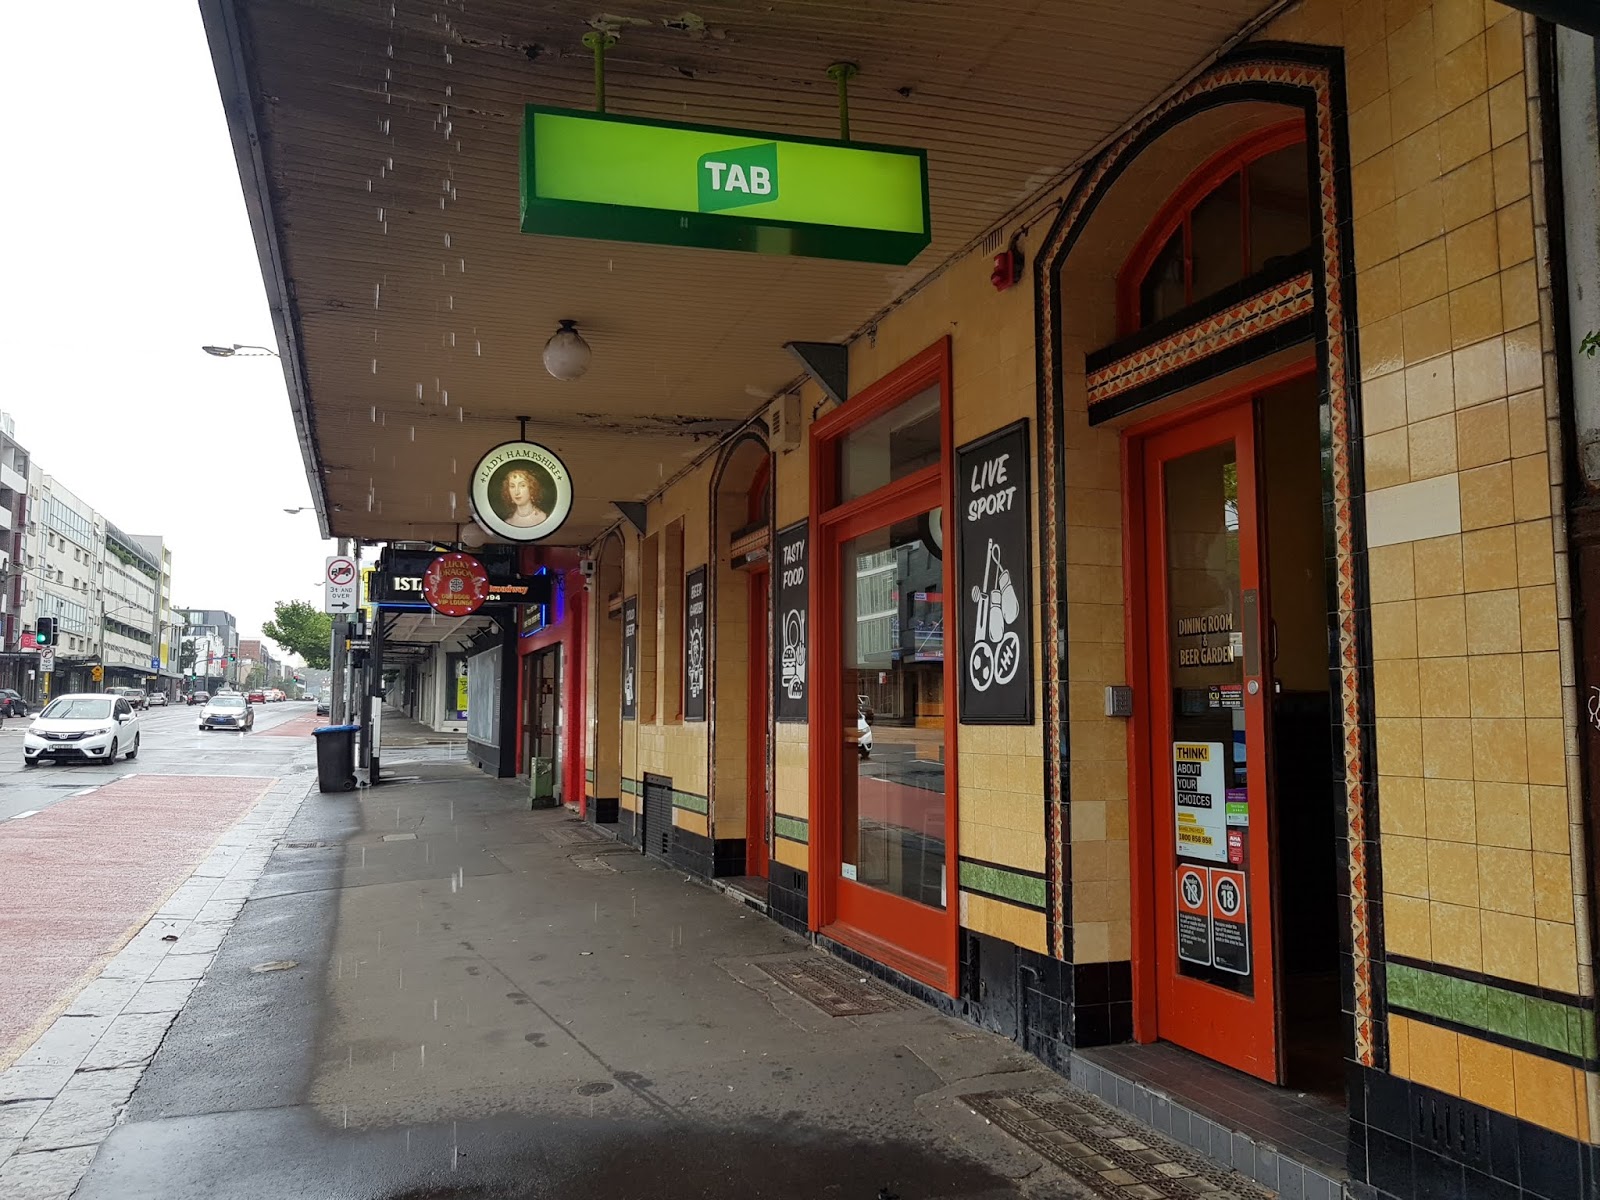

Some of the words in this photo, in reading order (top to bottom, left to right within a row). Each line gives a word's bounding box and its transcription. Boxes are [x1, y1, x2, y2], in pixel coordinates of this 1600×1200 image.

[704, 161, 771, 195] TAB
[482, 454, 504, 478] LADY
[506, 449, 561, 477] HAMPSHIRE
[971, 453, 1009, 493] LIVE
[967, 486, 1017, 522] SPORT
[783, 539, 805, 565] TASTY
[440, 568, 474, 579] DRAGON
[444, 560, 470, 569] LUCKY
[783, 566, 804, 590] FOOD
[1178, 617, 1207, 635] DINING
[1208, 613, 1233, 632] ROOM
[1202, 634, 1208, 647] &
[1180, 648, 1200, 666] BEER
[1201, 645, 1234, 664] GARDEN
[1208, 692, 1220, 700] ICU
[1177, 747, 1208, 760] THINK!
[1177, 763, 1201, 775] ABOUT
[1177, 778, 1197, 790] YOUR
[1178, 793, 1211, 807] CHOICES
[1186, 885, 1198, 902] 18
[1220, 890, 1235, 909] 18
